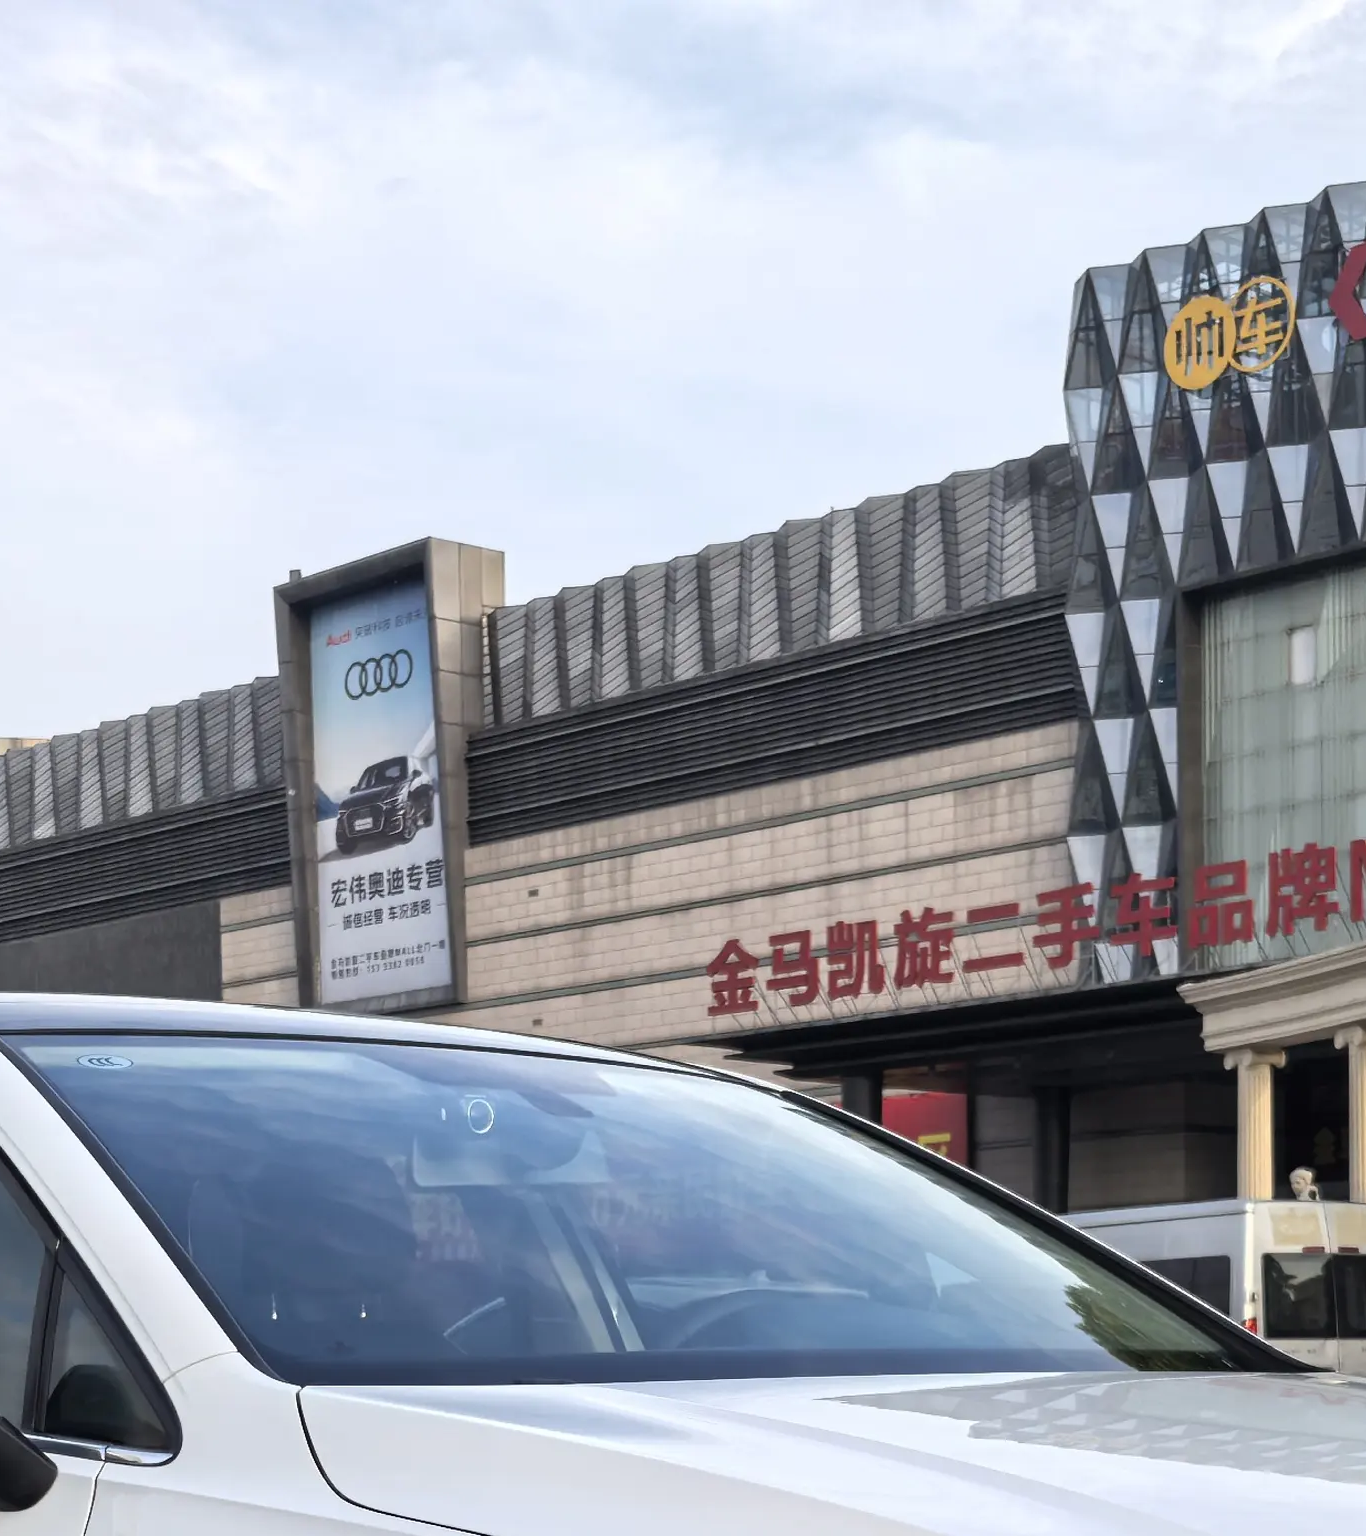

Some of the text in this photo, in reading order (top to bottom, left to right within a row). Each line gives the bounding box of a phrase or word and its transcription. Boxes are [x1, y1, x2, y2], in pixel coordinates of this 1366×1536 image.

[326, 629, 353, 647] Audi
[331, 859, 445, 908] 宏伟奥迪专营
